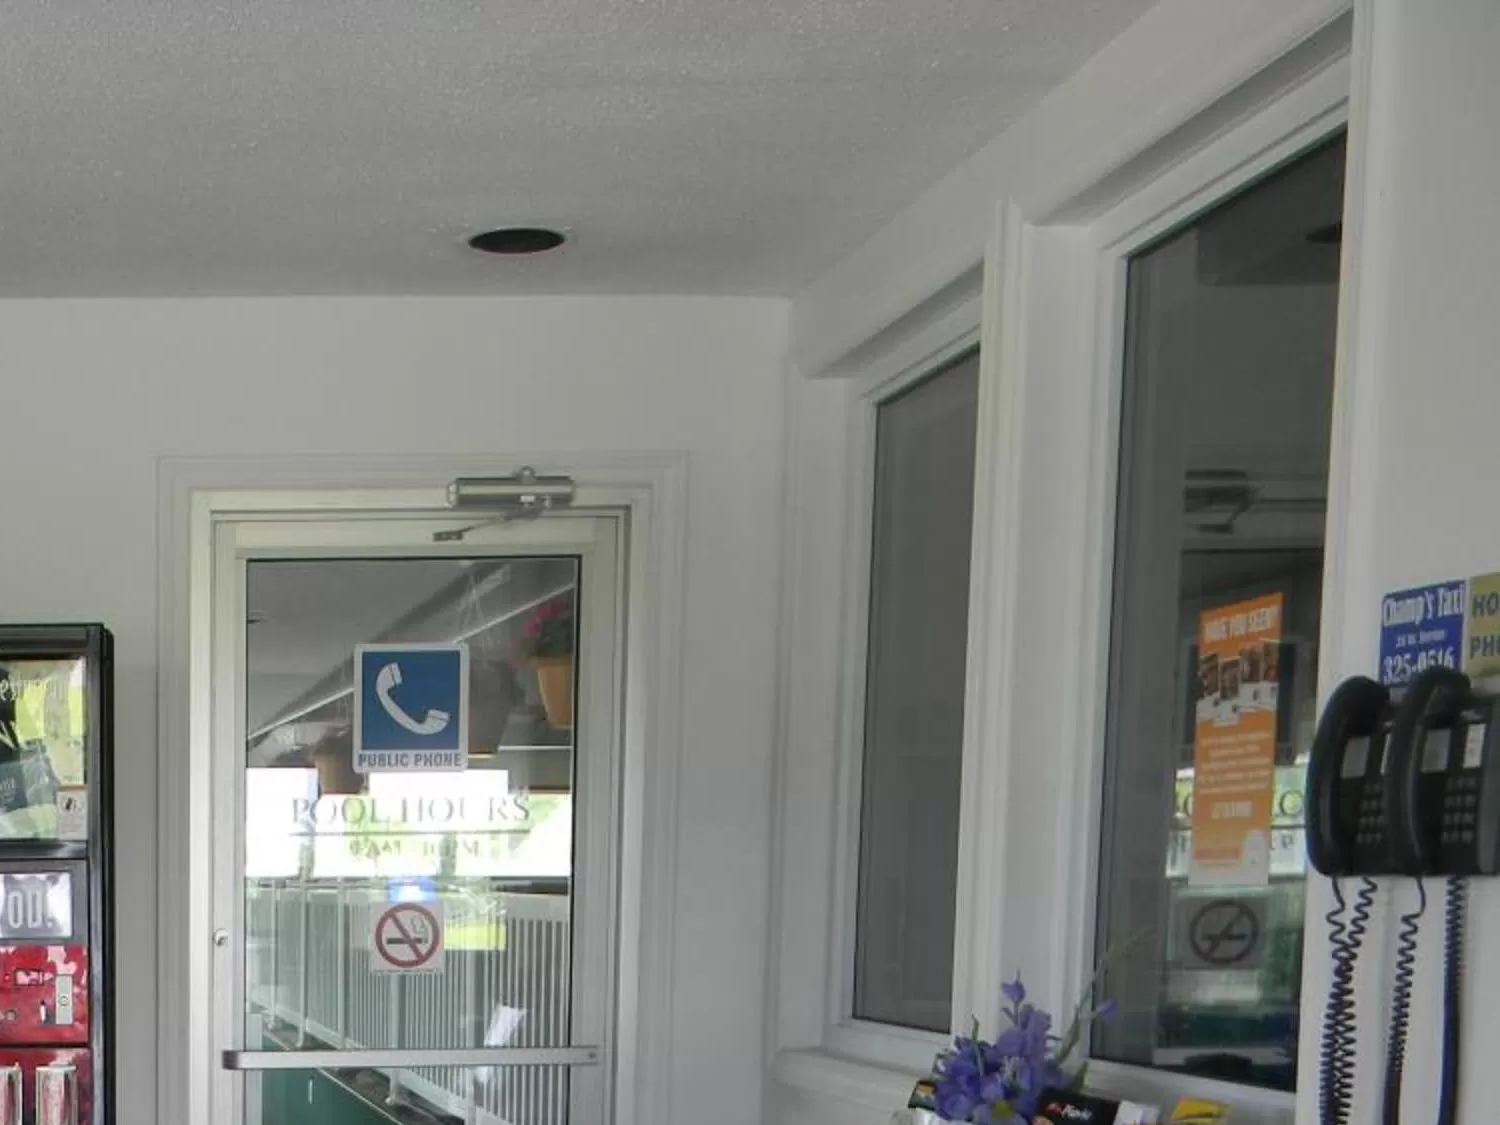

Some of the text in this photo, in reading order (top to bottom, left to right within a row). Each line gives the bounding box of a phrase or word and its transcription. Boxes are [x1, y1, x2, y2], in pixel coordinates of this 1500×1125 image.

[1437, 583, 1465, 617] Taxi
[1470, 635, 1500, 660] PH
[358, 752, 462, 768] PUBLIC PHONE
[291, 796, 385, 825] POOL
